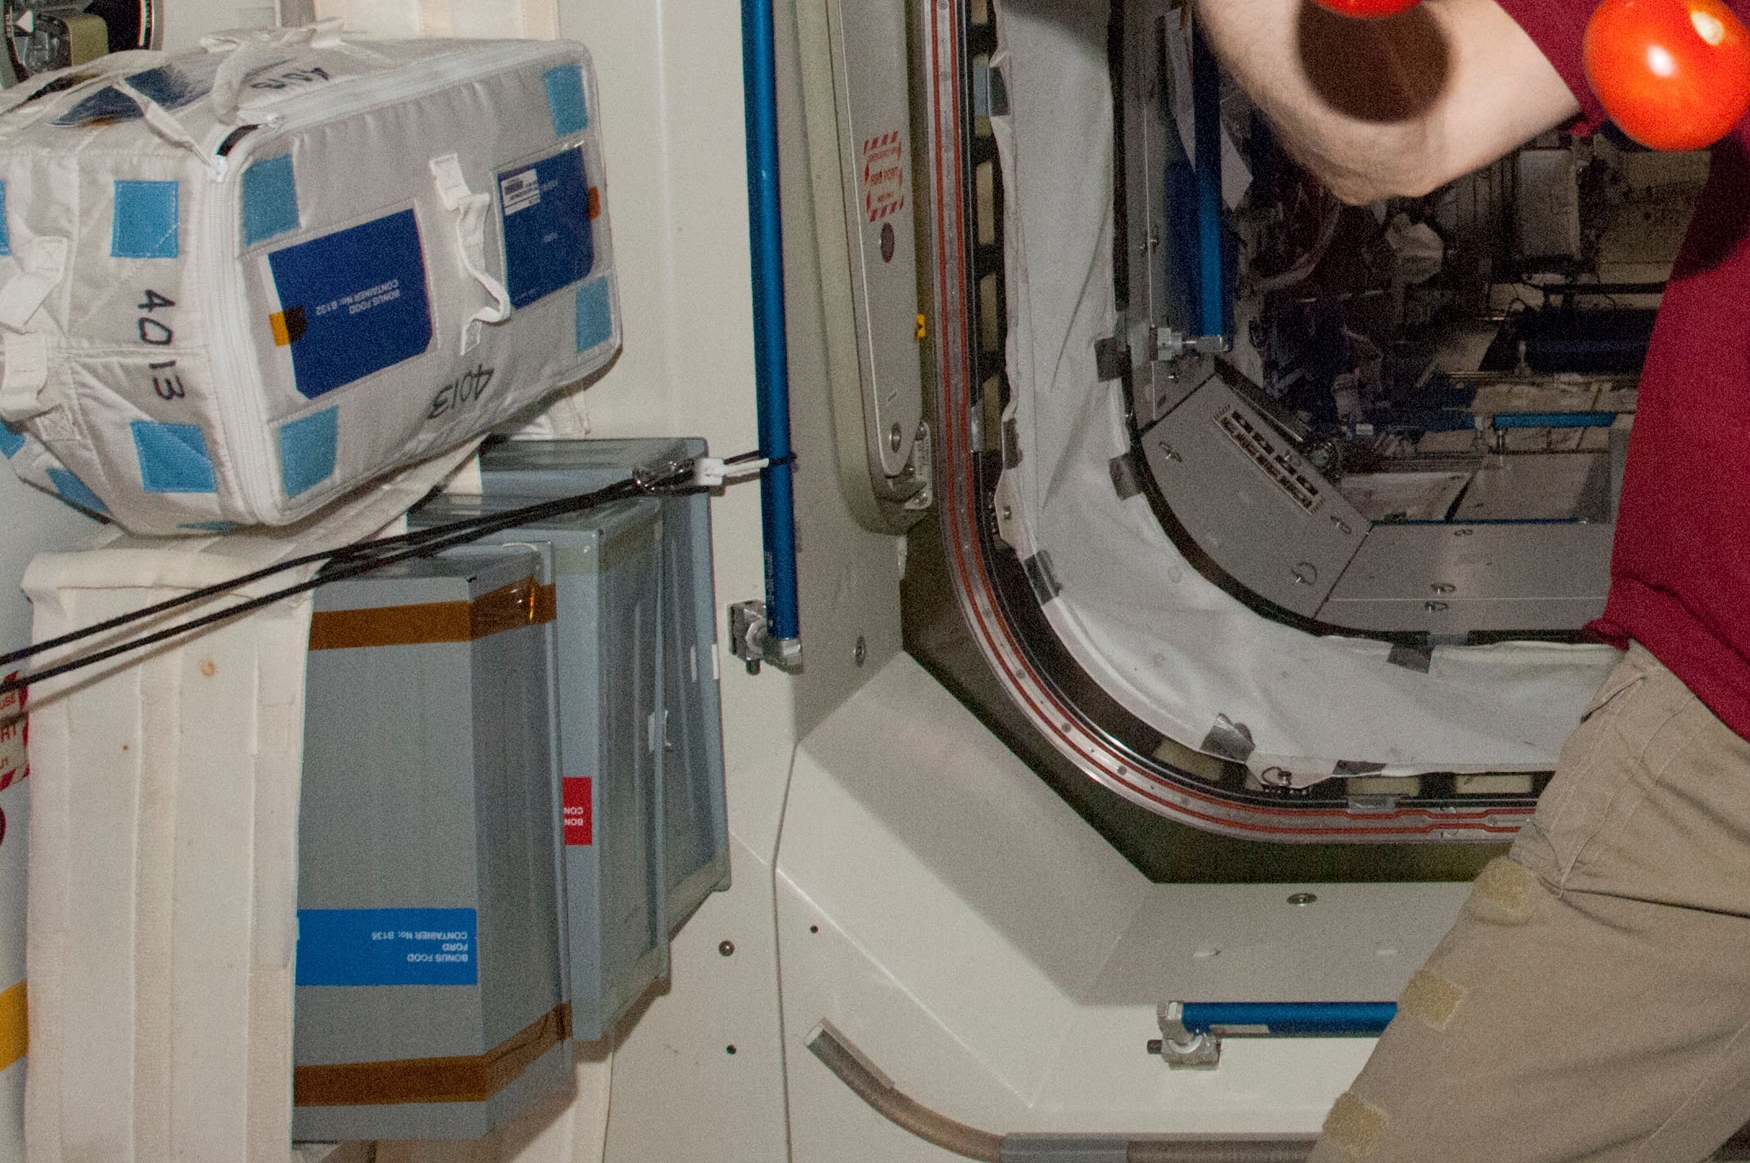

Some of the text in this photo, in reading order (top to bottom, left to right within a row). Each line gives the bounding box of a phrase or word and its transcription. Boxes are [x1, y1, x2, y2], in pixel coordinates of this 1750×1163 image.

[349, 300, 371, 315] FOOD
[138, 289, 185, 401] 4013
[427, 364, 495, 419] 4013
[415, 931, 467, 940] CONTAINER
[442, 943, 468, 951] FORD
[407, 953, 468, 962] BONUS FOOD
